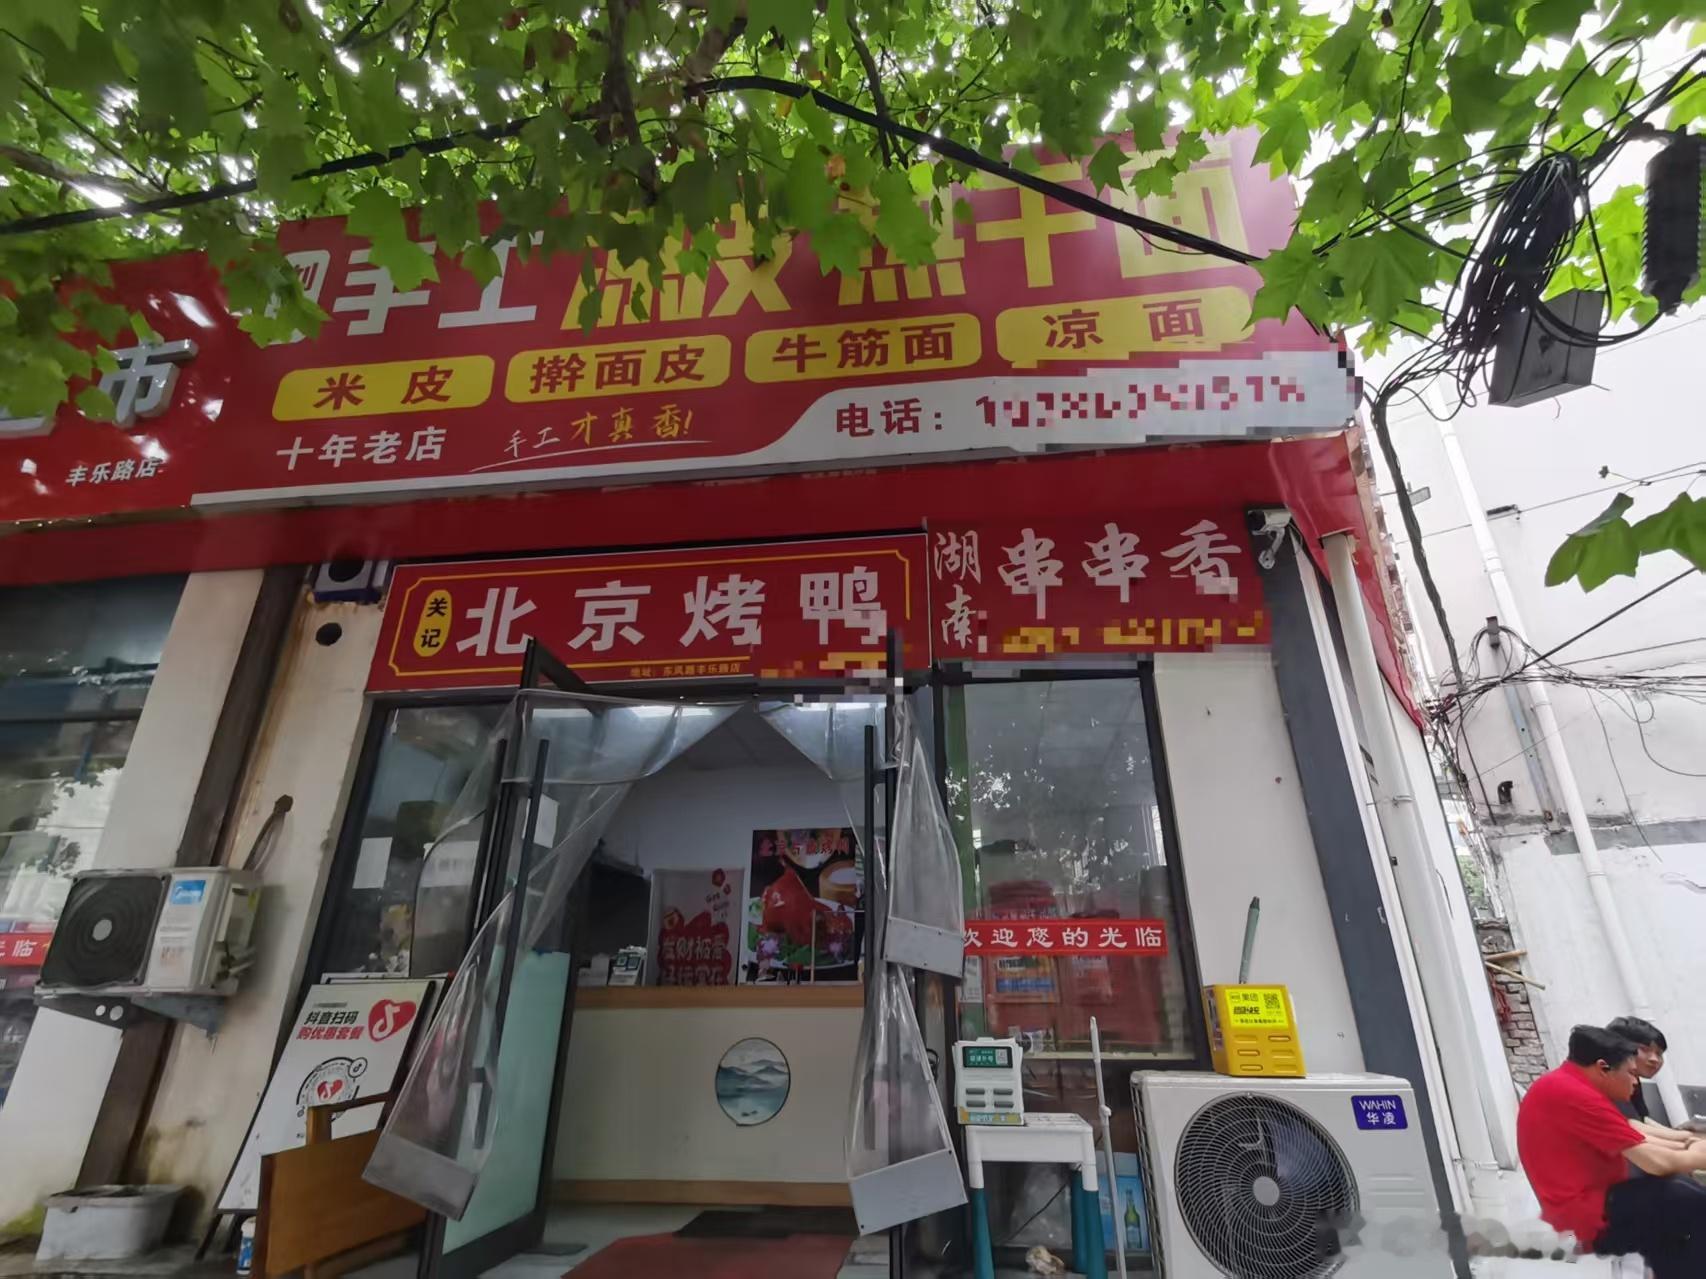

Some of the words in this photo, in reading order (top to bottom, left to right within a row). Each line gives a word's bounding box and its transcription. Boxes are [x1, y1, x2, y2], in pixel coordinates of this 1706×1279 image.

[1045, 297, 1204, 350] 凉面
[529, 343, 706, 395] 擀面皮
[772, 321, 956, 374] 牛筋面
[312, 363, 455, 410] 米皮
[276, 426, 447, 471] 十年老店
[65, 458, 164, 487] 丰乐路店
[996, 519, 1242, 620] 串串香
[426, 597, 448, 648] 关记
[456, 565, 887, 657] 北京烤鸭
[296, 1025, 365, 1040] 购优惠套餐
[304, 1010, 359, 1025] 抖音扫码
[1359, 1099, 1397, 1111] WAHIN
[1366, 1111, 1397, 1126] 华凌
